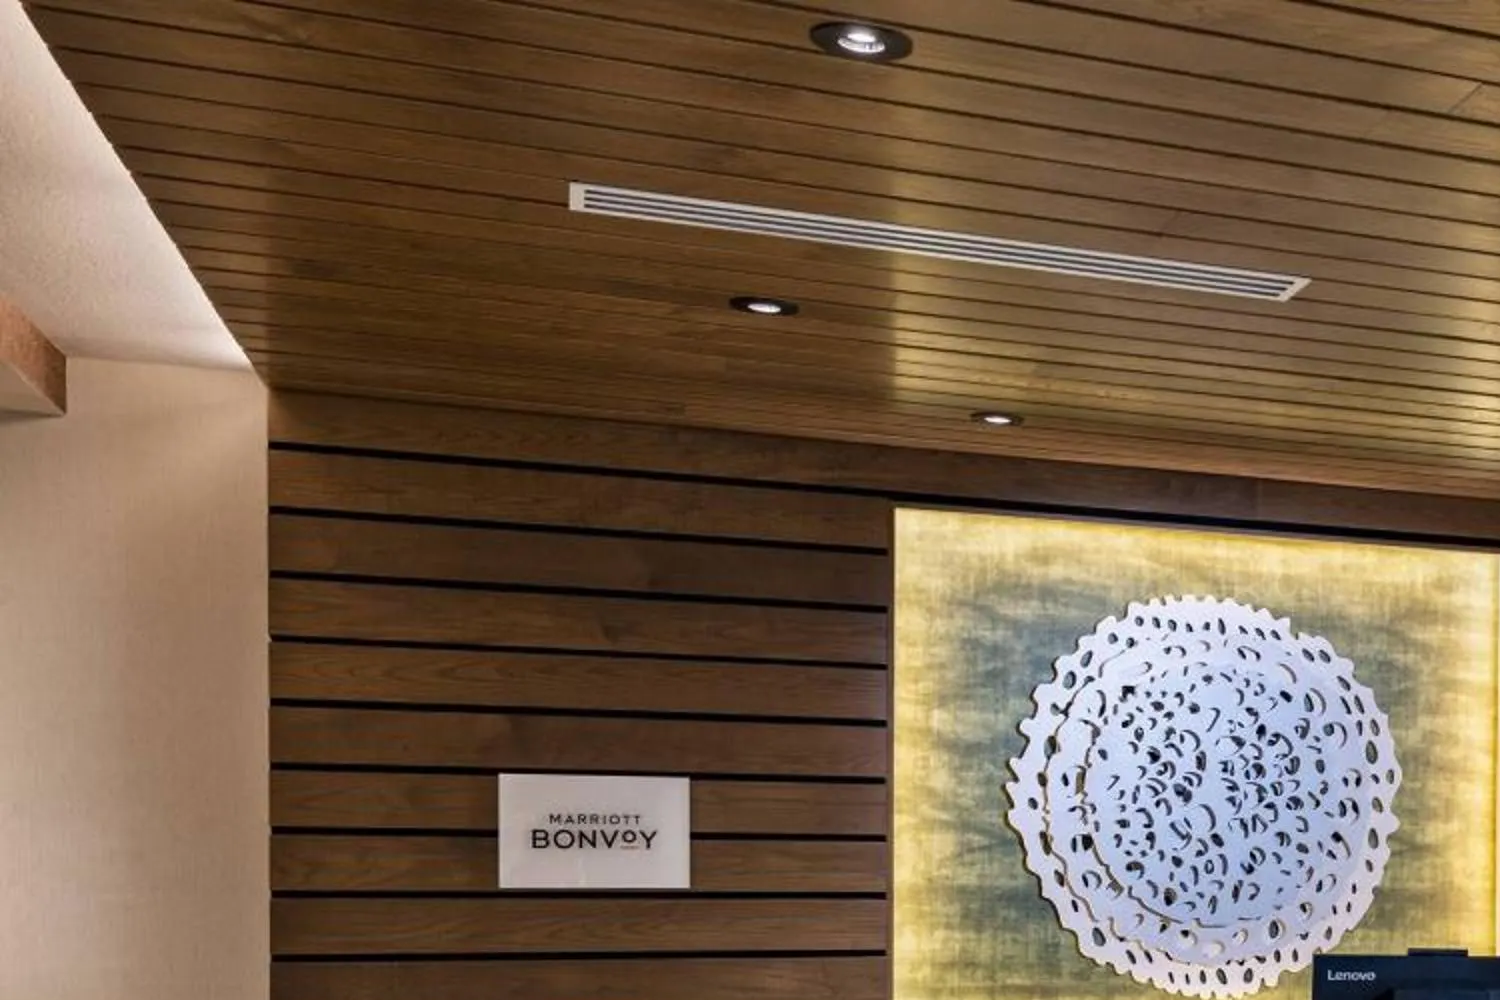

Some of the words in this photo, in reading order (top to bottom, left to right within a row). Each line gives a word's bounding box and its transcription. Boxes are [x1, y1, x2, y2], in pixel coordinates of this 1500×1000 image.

[549, 813, 641, 825] MARRIOTT
[531, 829, 658, 849] BONVOY
[1327, 969, 1377, 982] Lenovo
